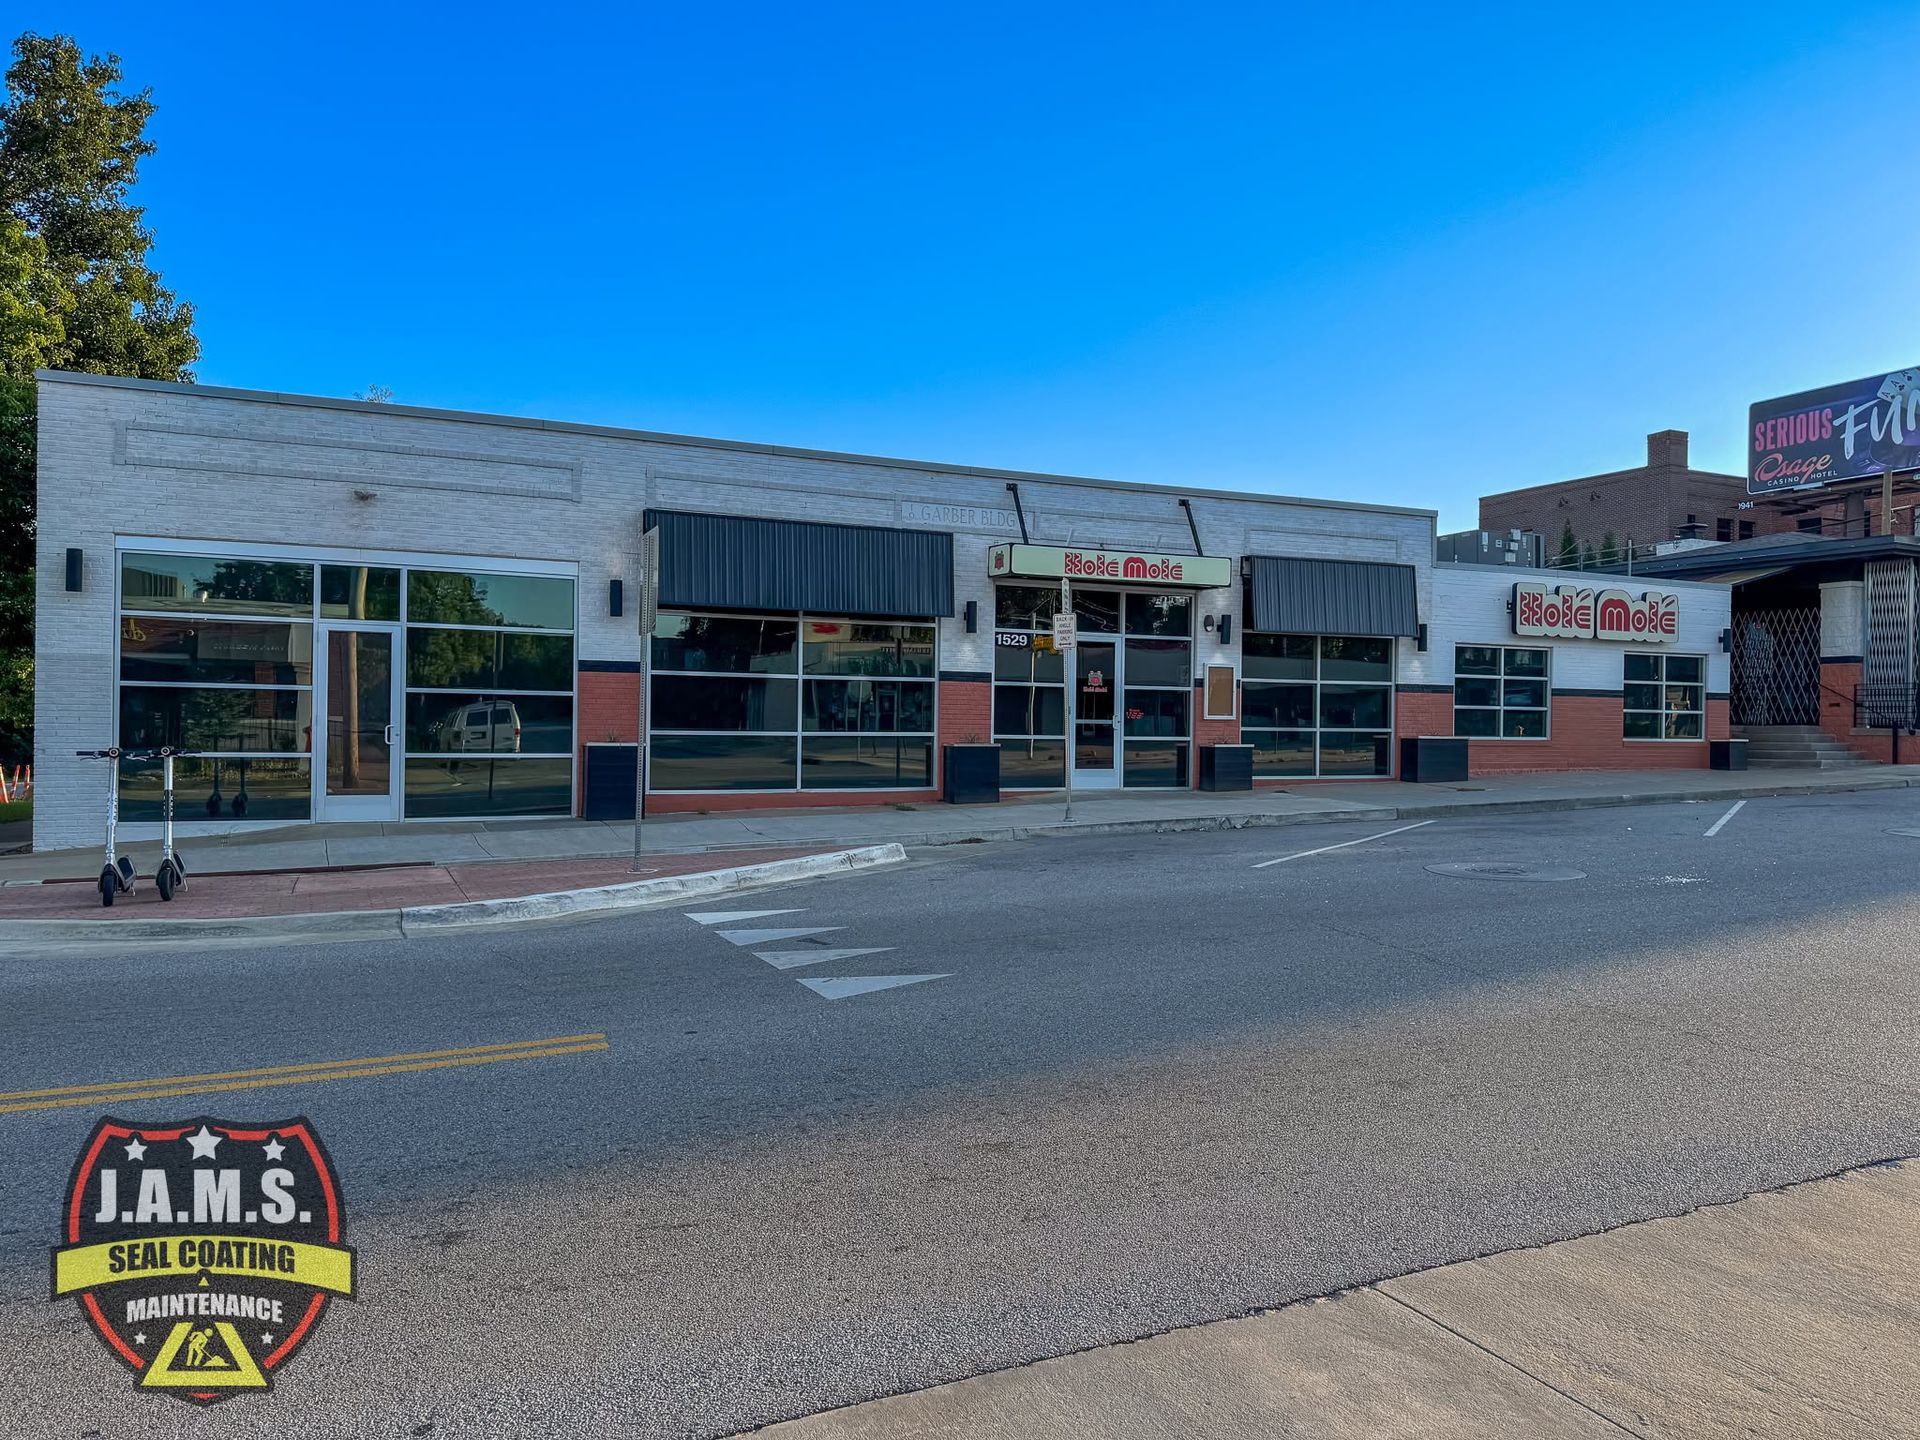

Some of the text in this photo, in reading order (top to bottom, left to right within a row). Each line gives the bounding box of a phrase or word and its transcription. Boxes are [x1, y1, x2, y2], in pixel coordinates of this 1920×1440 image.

[1754, 408, 1833, 452] SERIOUS
[1754, 453, 1833, 484] Osage
[1767, 470, 1838, 487] CASINO HOTEL
[921, 505, 977, 526] GARBER
[995, 633, 1028, 646] 1529
